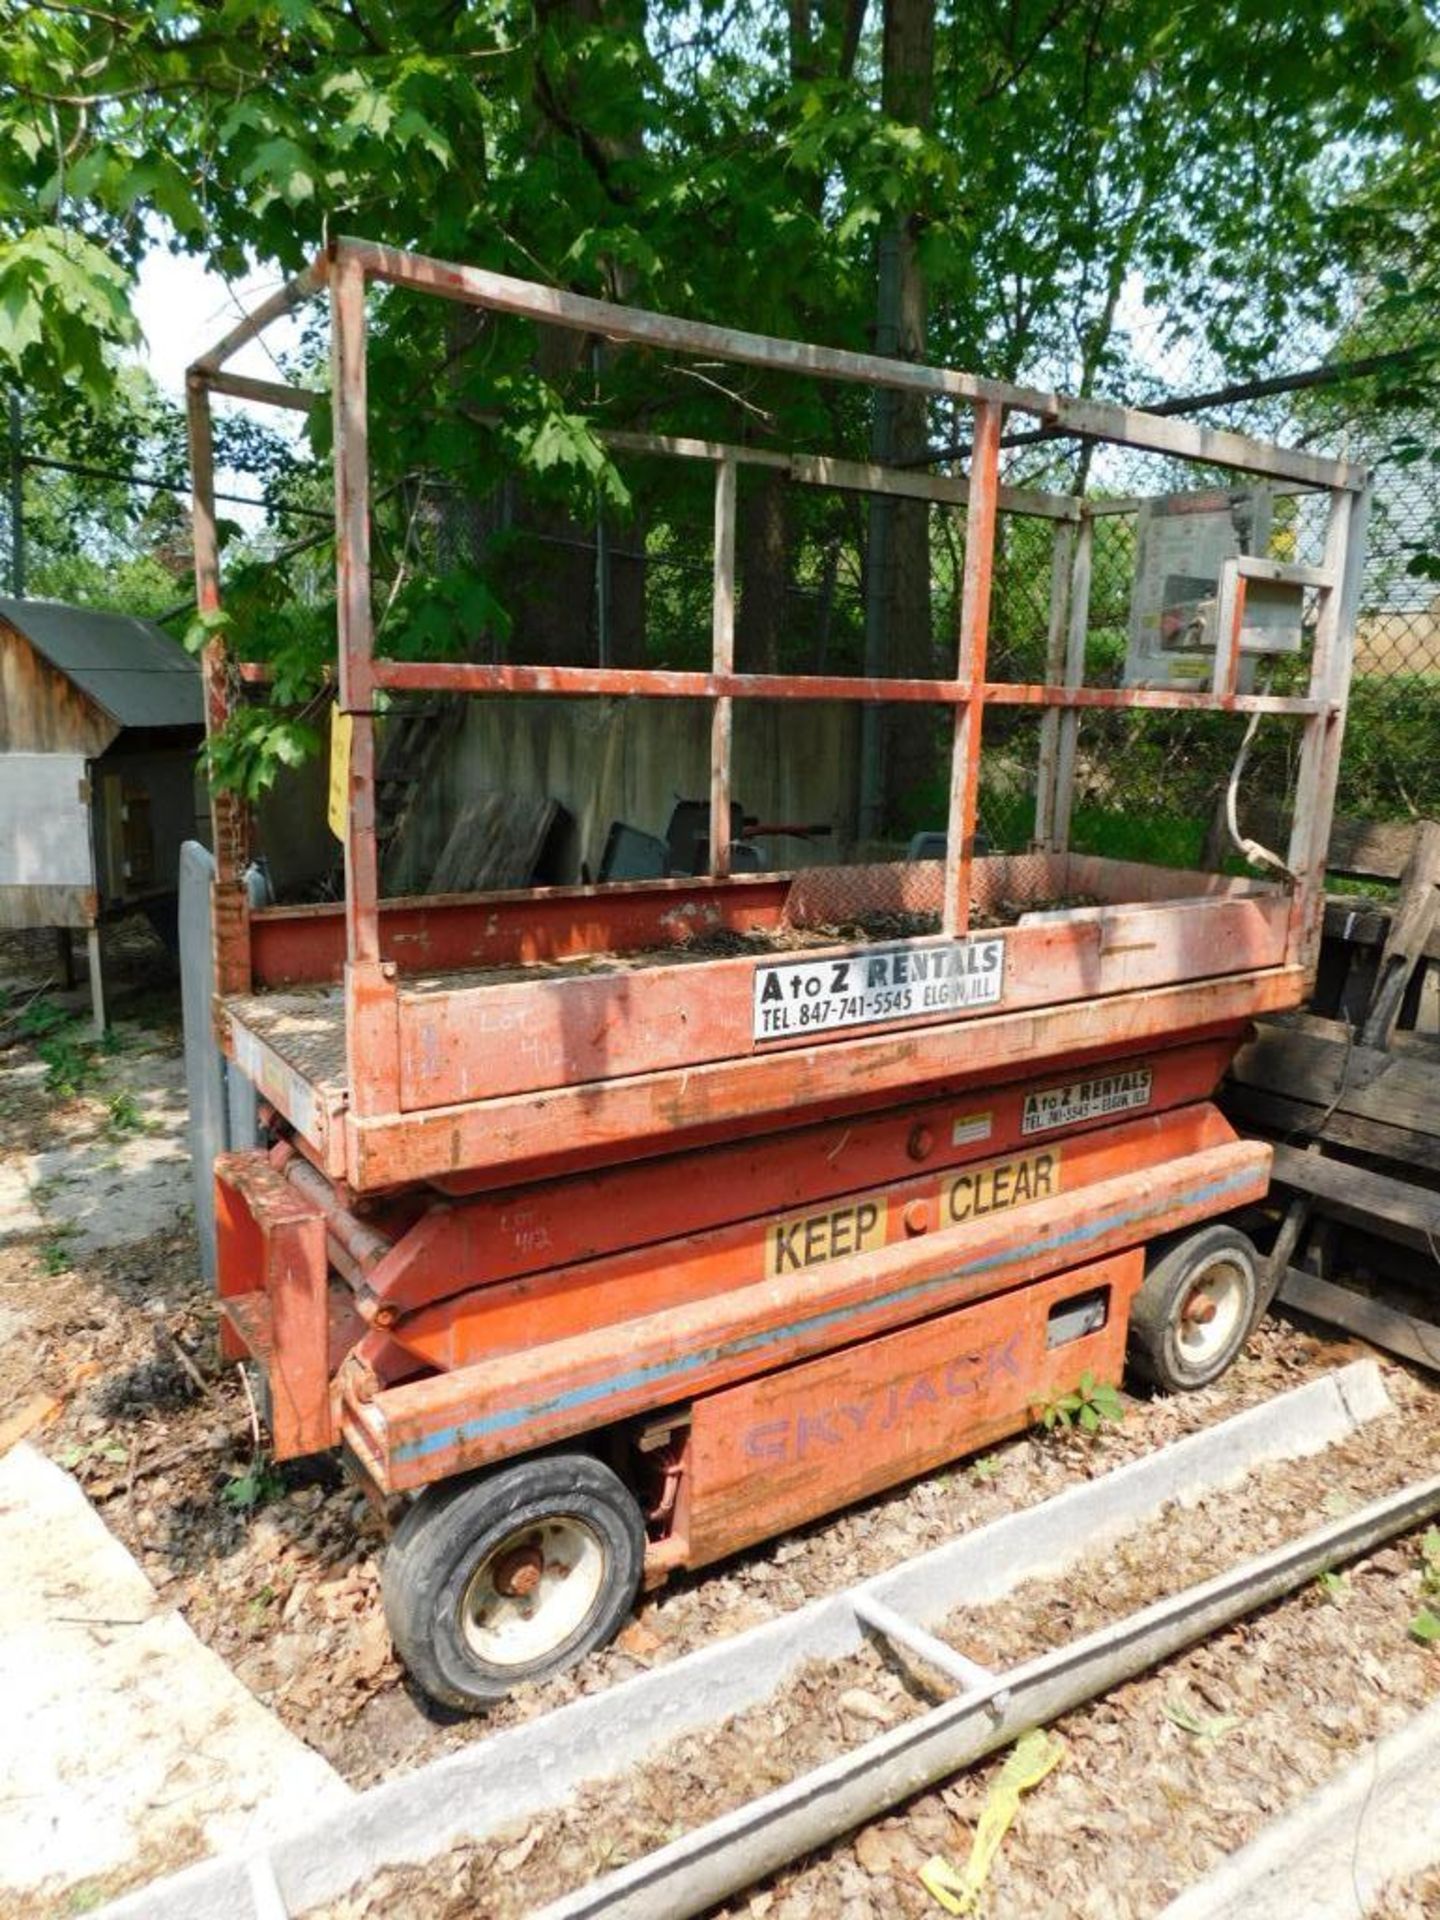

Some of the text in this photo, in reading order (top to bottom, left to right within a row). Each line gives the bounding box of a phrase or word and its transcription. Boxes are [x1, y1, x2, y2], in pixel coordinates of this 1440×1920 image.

[761, 945, 998, 1004] A to Z RENTALS
[1027, 1071, 1149, 1114] A to Z RENTALS
[775, 1153, 1053, 1274] KEEP CLEAR
[744, 1330, 1022, 1462] SKYJACK
